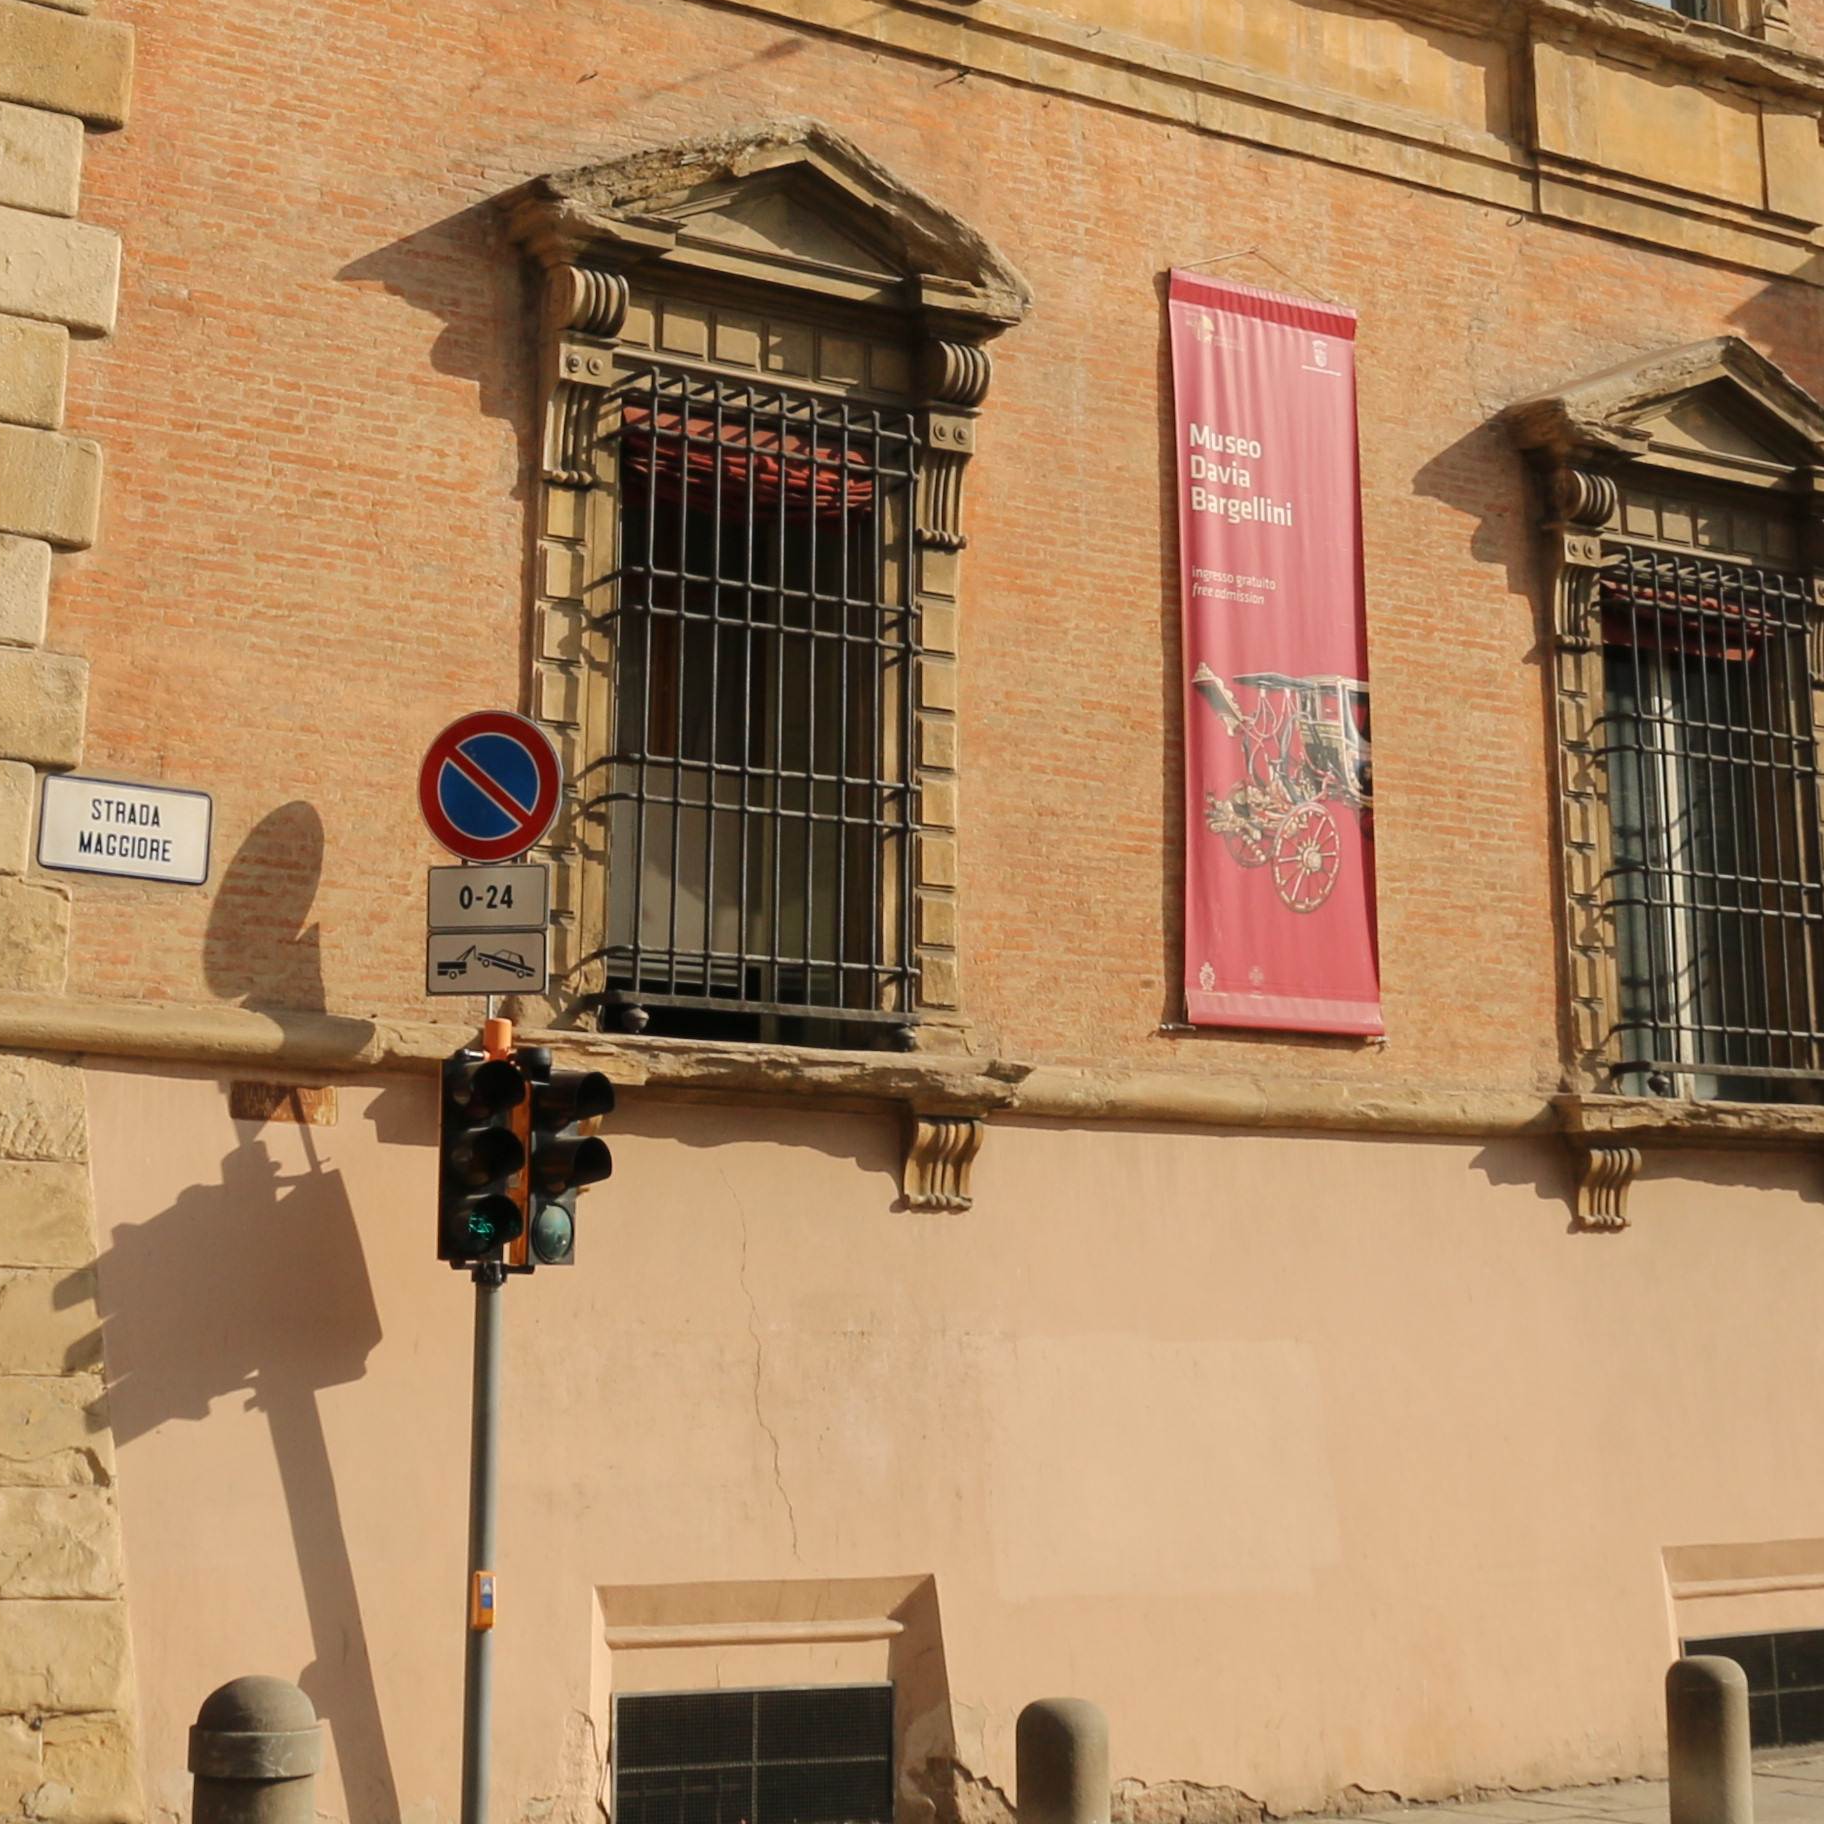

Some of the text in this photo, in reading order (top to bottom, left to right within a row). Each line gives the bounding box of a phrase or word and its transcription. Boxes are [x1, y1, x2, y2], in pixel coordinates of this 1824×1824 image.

[1189, 423, 1262, 459] Museo
[1190, 454, 1251, 488] Davia
[1191, 486, 1293, 526] Bargellini
[1192, 565, 1277, 591] ingresso gratuito
[1192, 582, 1265, 605] free admission
[91, 798, 161, 828] STRADA
[78, 830, 172, 862] MAGGIORE
[459, 884, 513, 910] 0-24
